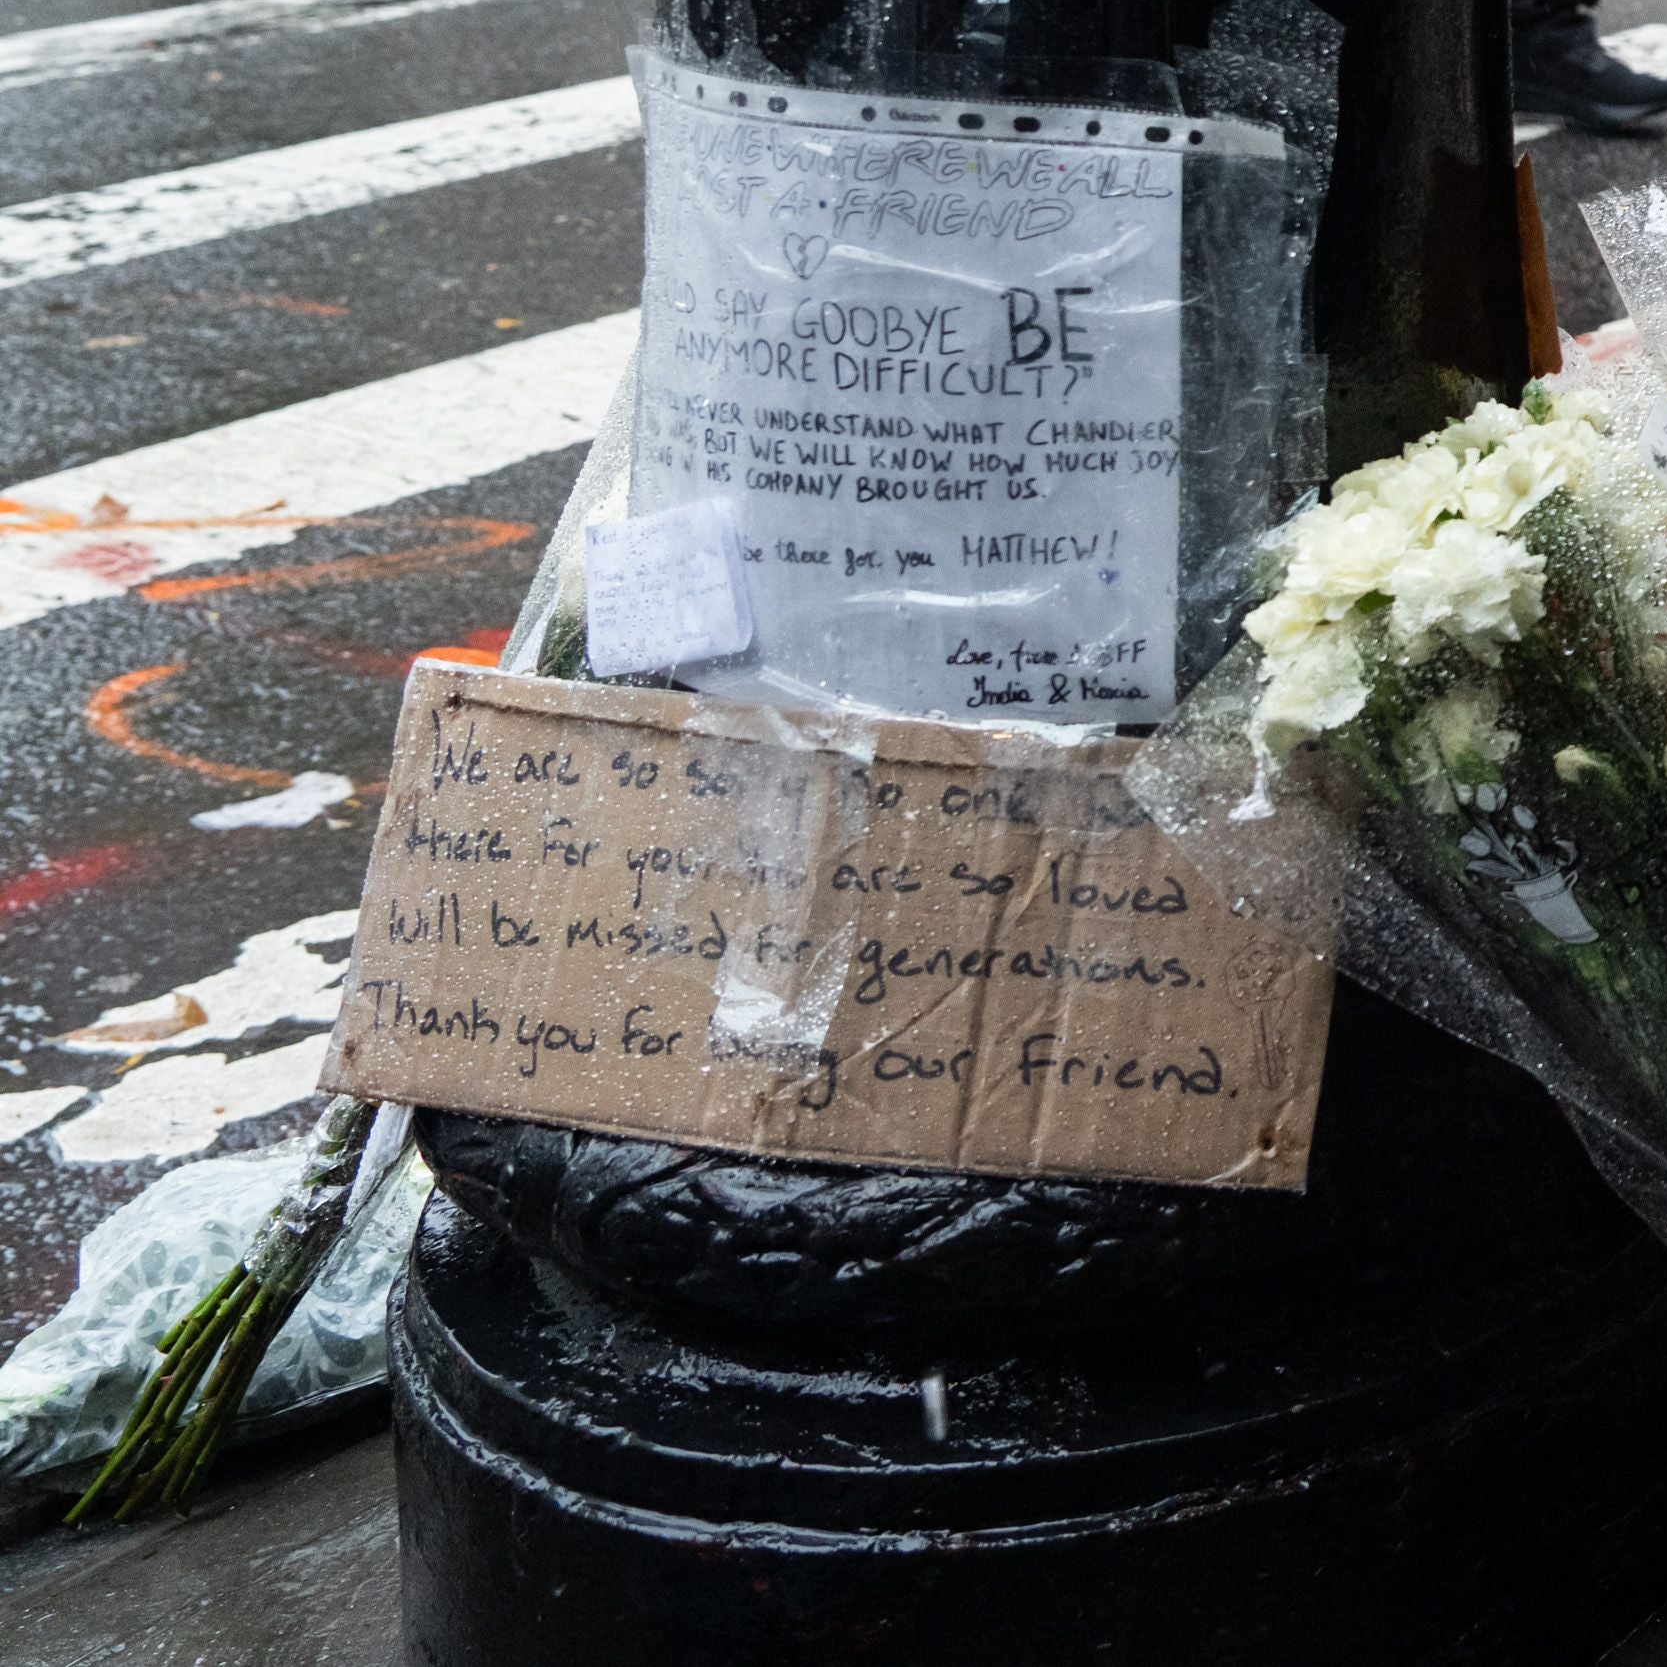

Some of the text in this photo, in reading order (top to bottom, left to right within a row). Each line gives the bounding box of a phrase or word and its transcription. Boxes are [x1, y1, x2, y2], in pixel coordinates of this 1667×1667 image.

[974, 147, 1057, 192] WE
[1058, 154, 1174, 200] ALL
[833, 186, 1075, 242] FRIEND
[1001, 285, 1097, 366] BE
[753, 406, 914, 440] UNDERSTAND
[922, 420, 1005, 445] WHAT
[748, 434, 787, 467] WE
[795, 440, 857, 468] WILL
[869, 445, 953, 473] KNOW
[967, 450, 1026, 478] HOW
[1045, 448, 1121, 476] MUCH
[745, 467, 843, 501] COMPANY
[855, 475, 990, 504] BROUGHT
[1047, 672, 1073, 706] &
[431, 709, 488, 795] We
[513, 750, 581, 786] are
[1050, 854, 1187, 916] loved
[361, 979, 500, 1045] Thank
[516, 1013, 598, 1079] you
[871, 1047, 978, 1087] our
